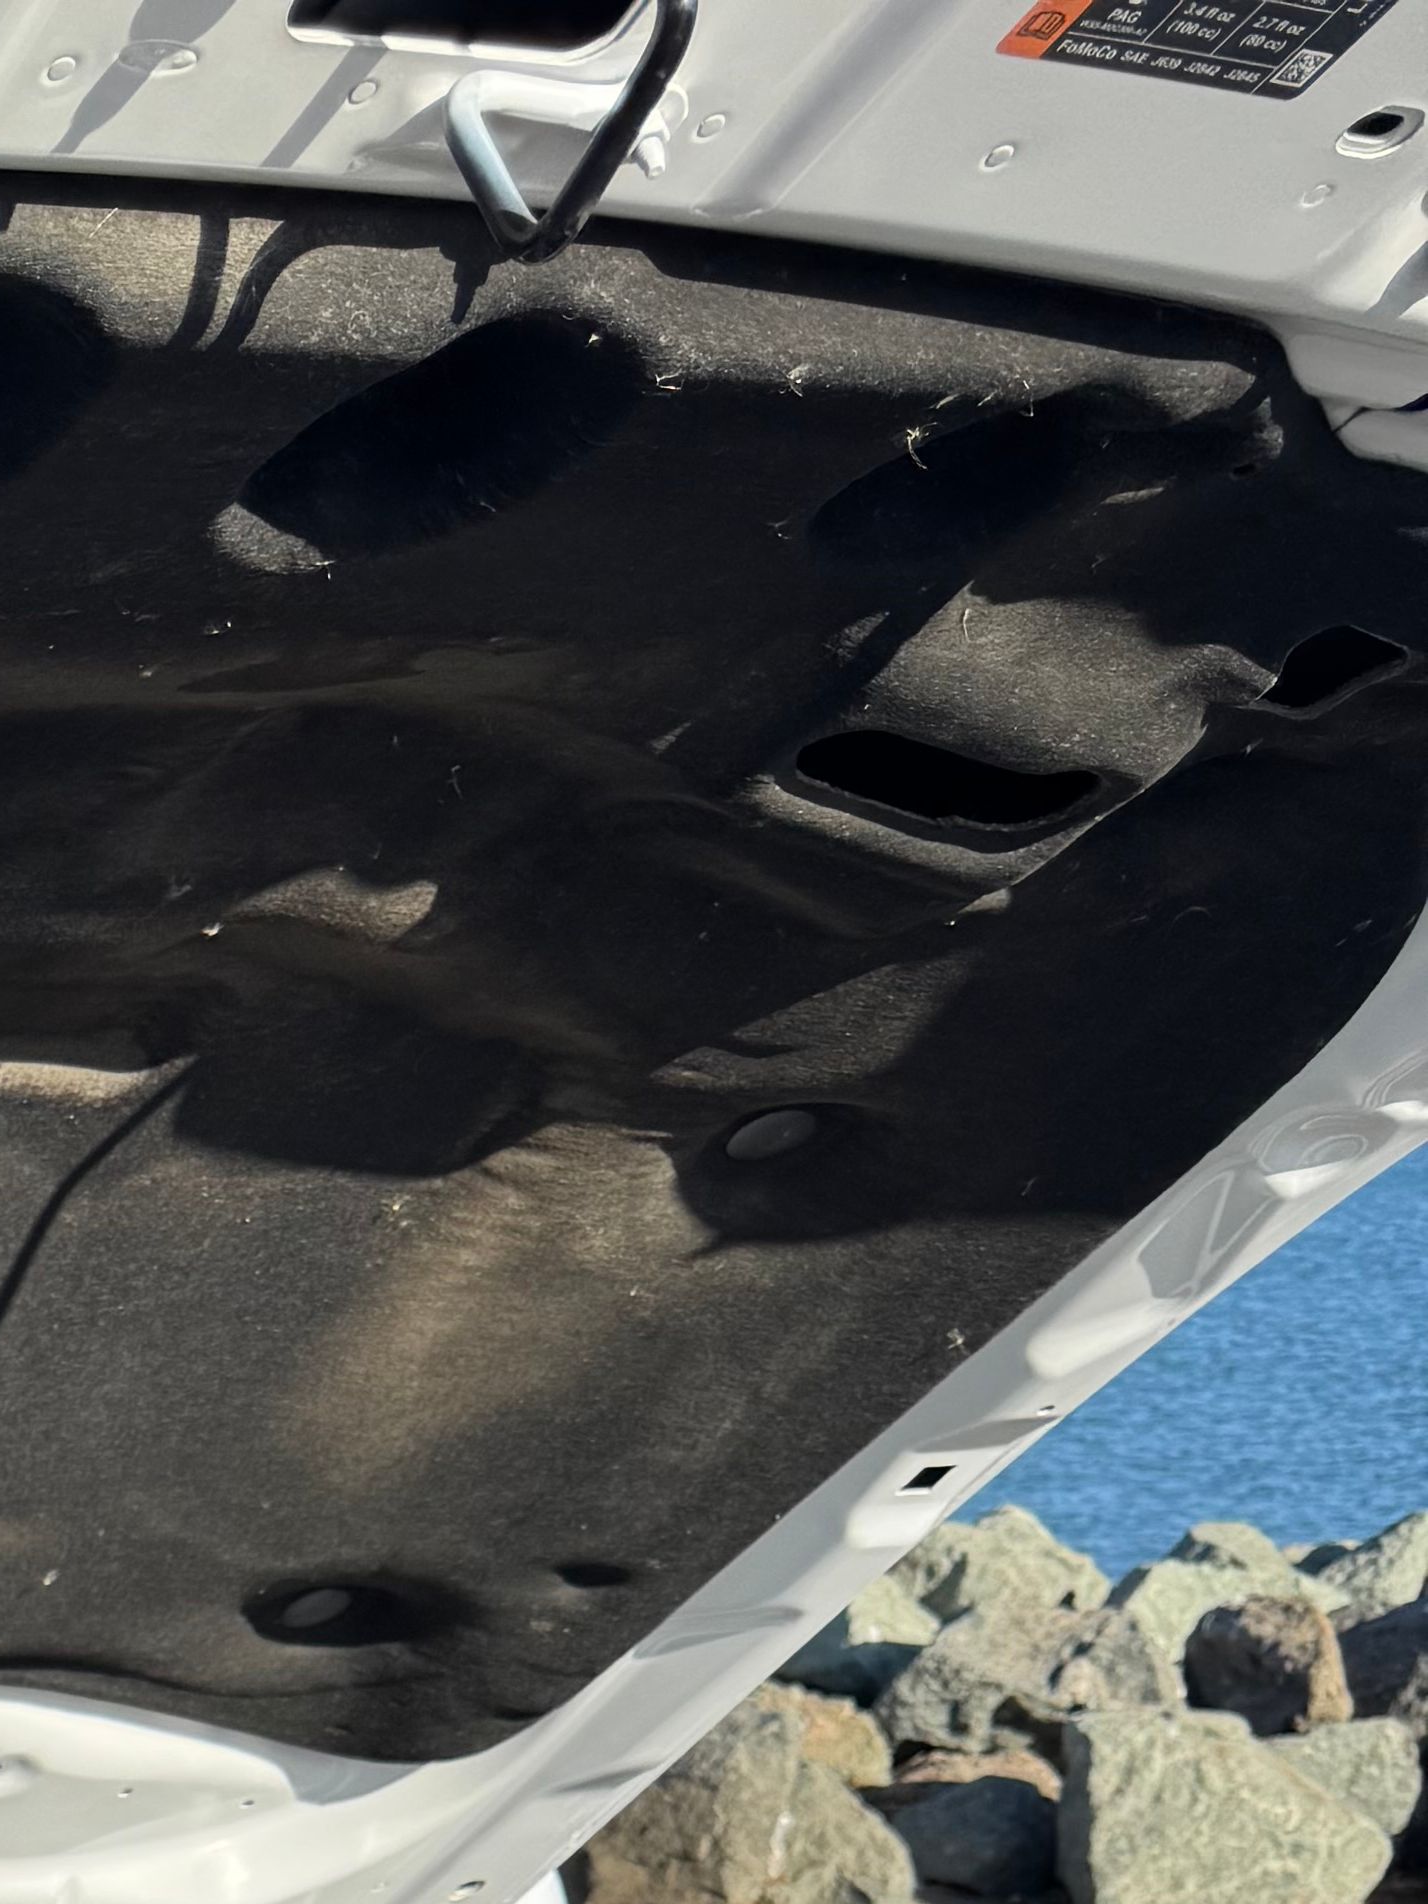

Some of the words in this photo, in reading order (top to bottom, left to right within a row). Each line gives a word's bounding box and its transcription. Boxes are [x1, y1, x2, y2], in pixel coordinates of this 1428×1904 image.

[1107, 8, 1142, 24] PAG
[1252, 16, 1276, 30] 2.7
[1286, 24, 1307, 36] oz
[1166, 20, 1197, 36] (100
[1197, 28, 1223, 41] cc)
[1056, 39, 1117, 60] FoMoCo
[1120, 51, 1150, 65] SAE
[1262, 40, 1288, 53] cc)
